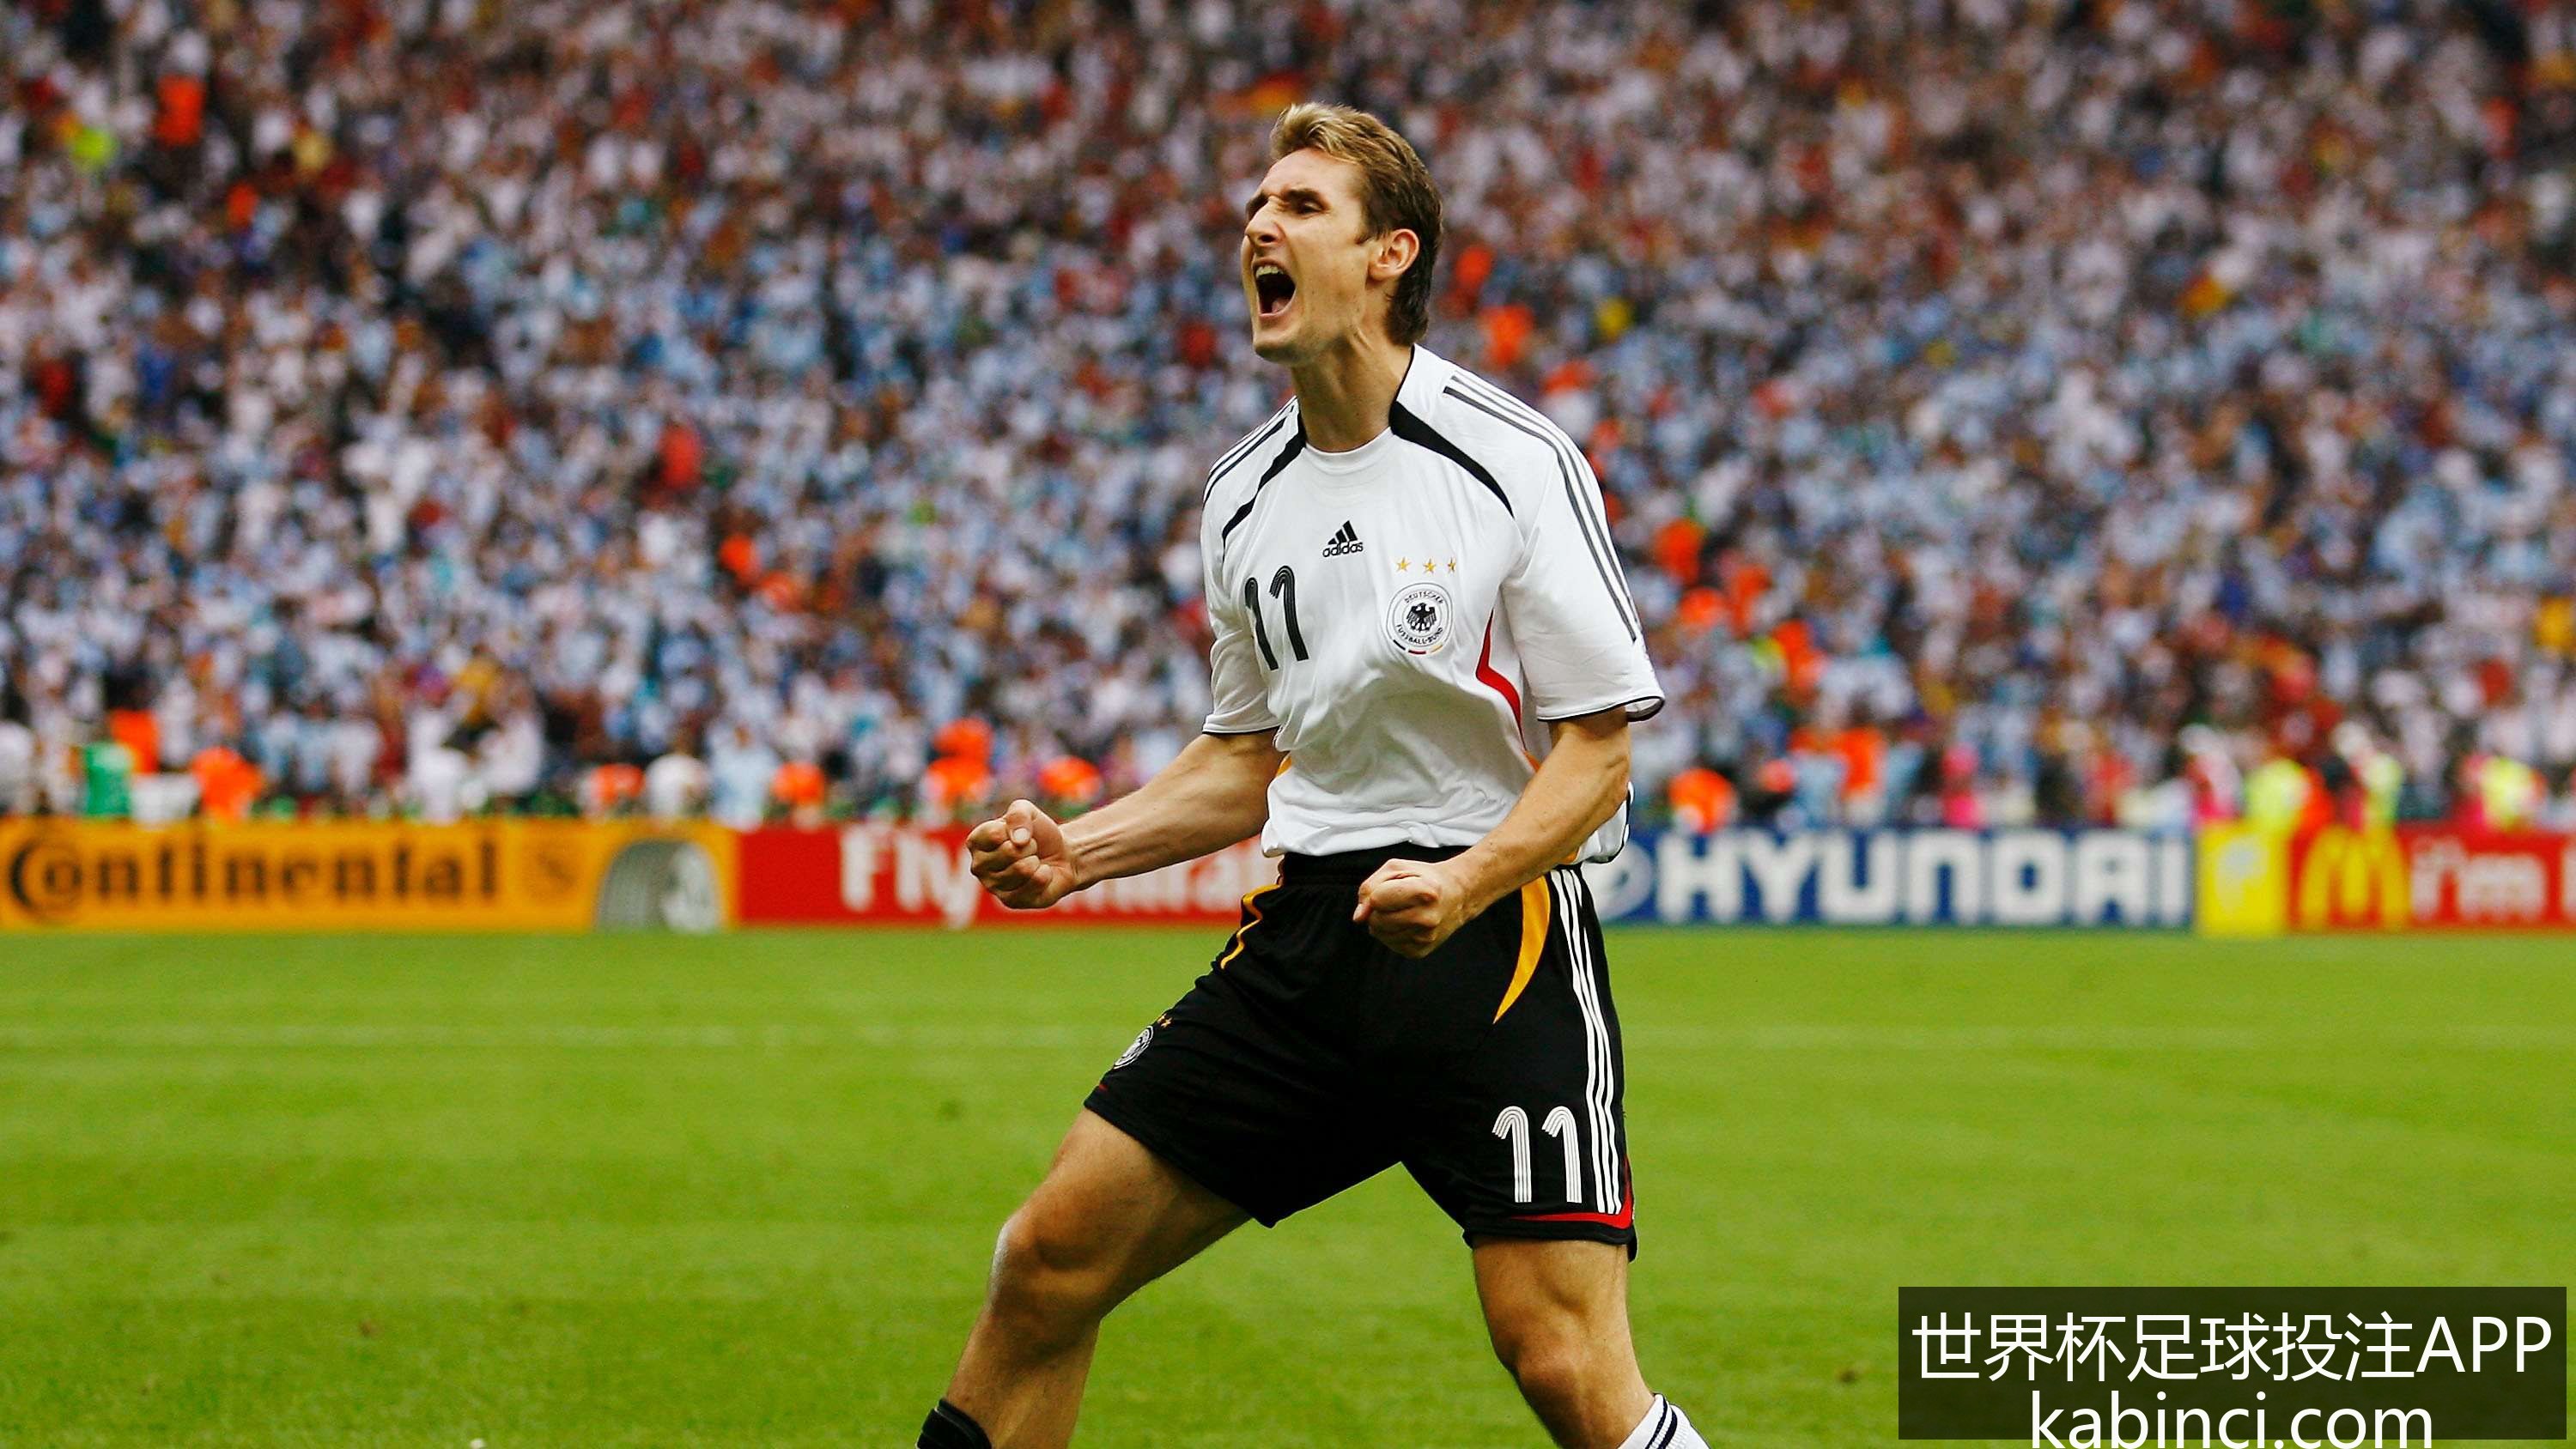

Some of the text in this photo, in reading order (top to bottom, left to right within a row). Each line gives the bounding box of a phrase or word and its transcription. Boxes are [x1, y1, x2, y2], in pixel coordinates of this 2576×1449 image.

[1322, 541, 1364, 558] adidas
[1245, 565, 1309, 670] 11
[1404, 590, 1444, 605] DEUTSCHER
[7, 836, 500, 924] Continental
[841, 826, 981, 930] Fly
[1657, 833, 2188, 925] HYUNDAI
[1492, 1106, 1583, 1203] 11
